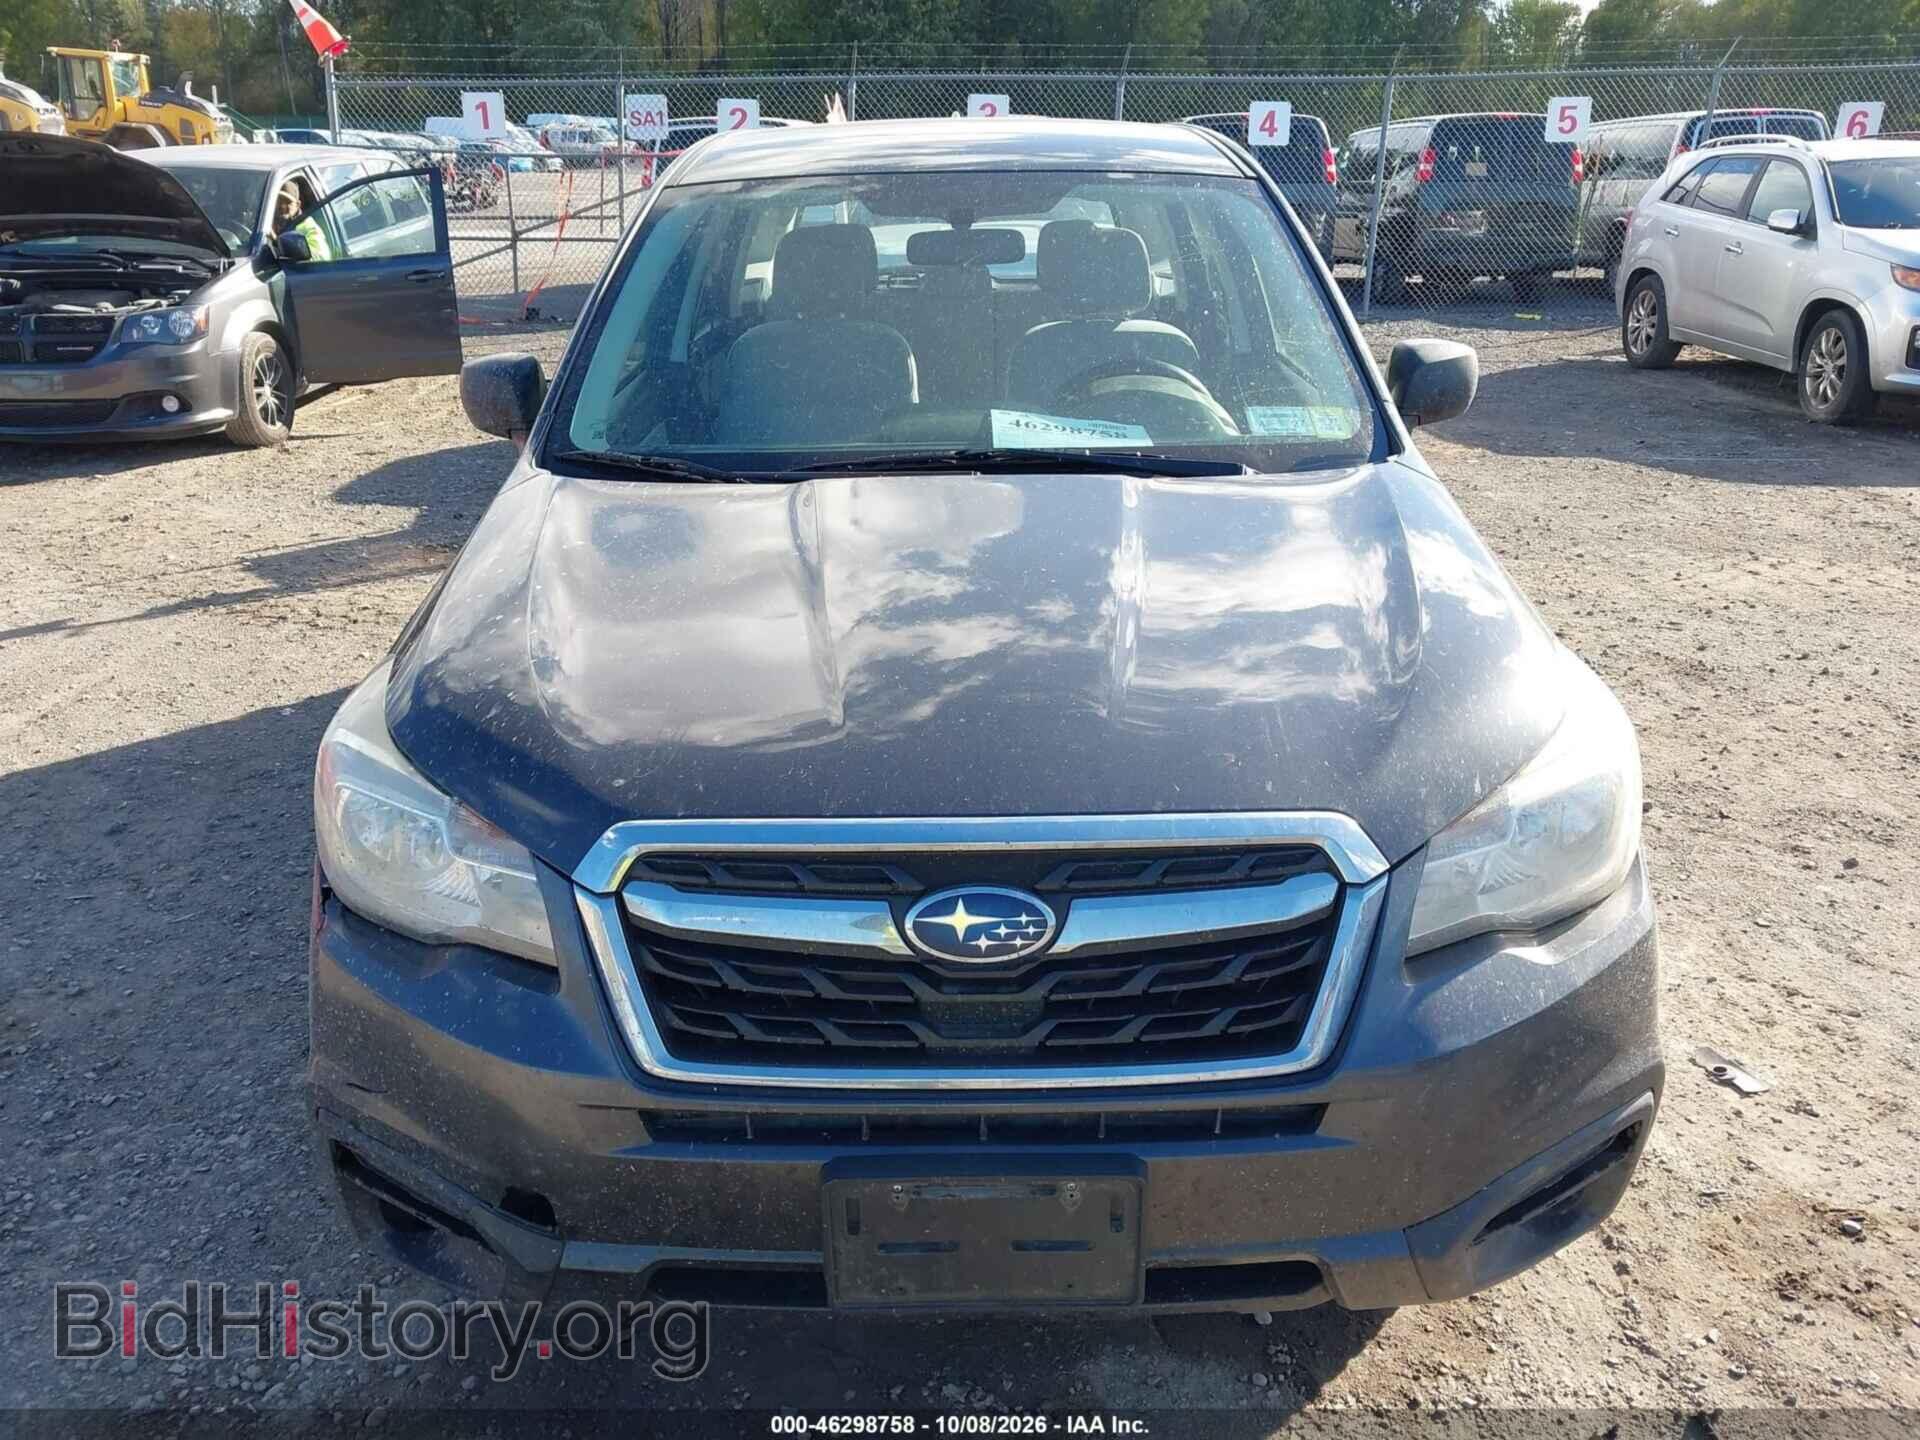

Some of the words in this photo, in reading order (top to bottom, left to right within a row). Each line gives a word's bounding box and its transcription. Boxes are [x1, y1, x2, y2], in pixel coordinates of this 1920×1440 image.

[475, 101, 490, 130] 1
[630, 110, 664, 127] SA1
[729, 107, 748, 130] 2
[1259, 110, 1278, 138] 4
[1558, 105, 1578, 135] 5
[1846, 110, 1869, 137] 6
[1007, 418, 1129, 439] 46298758
